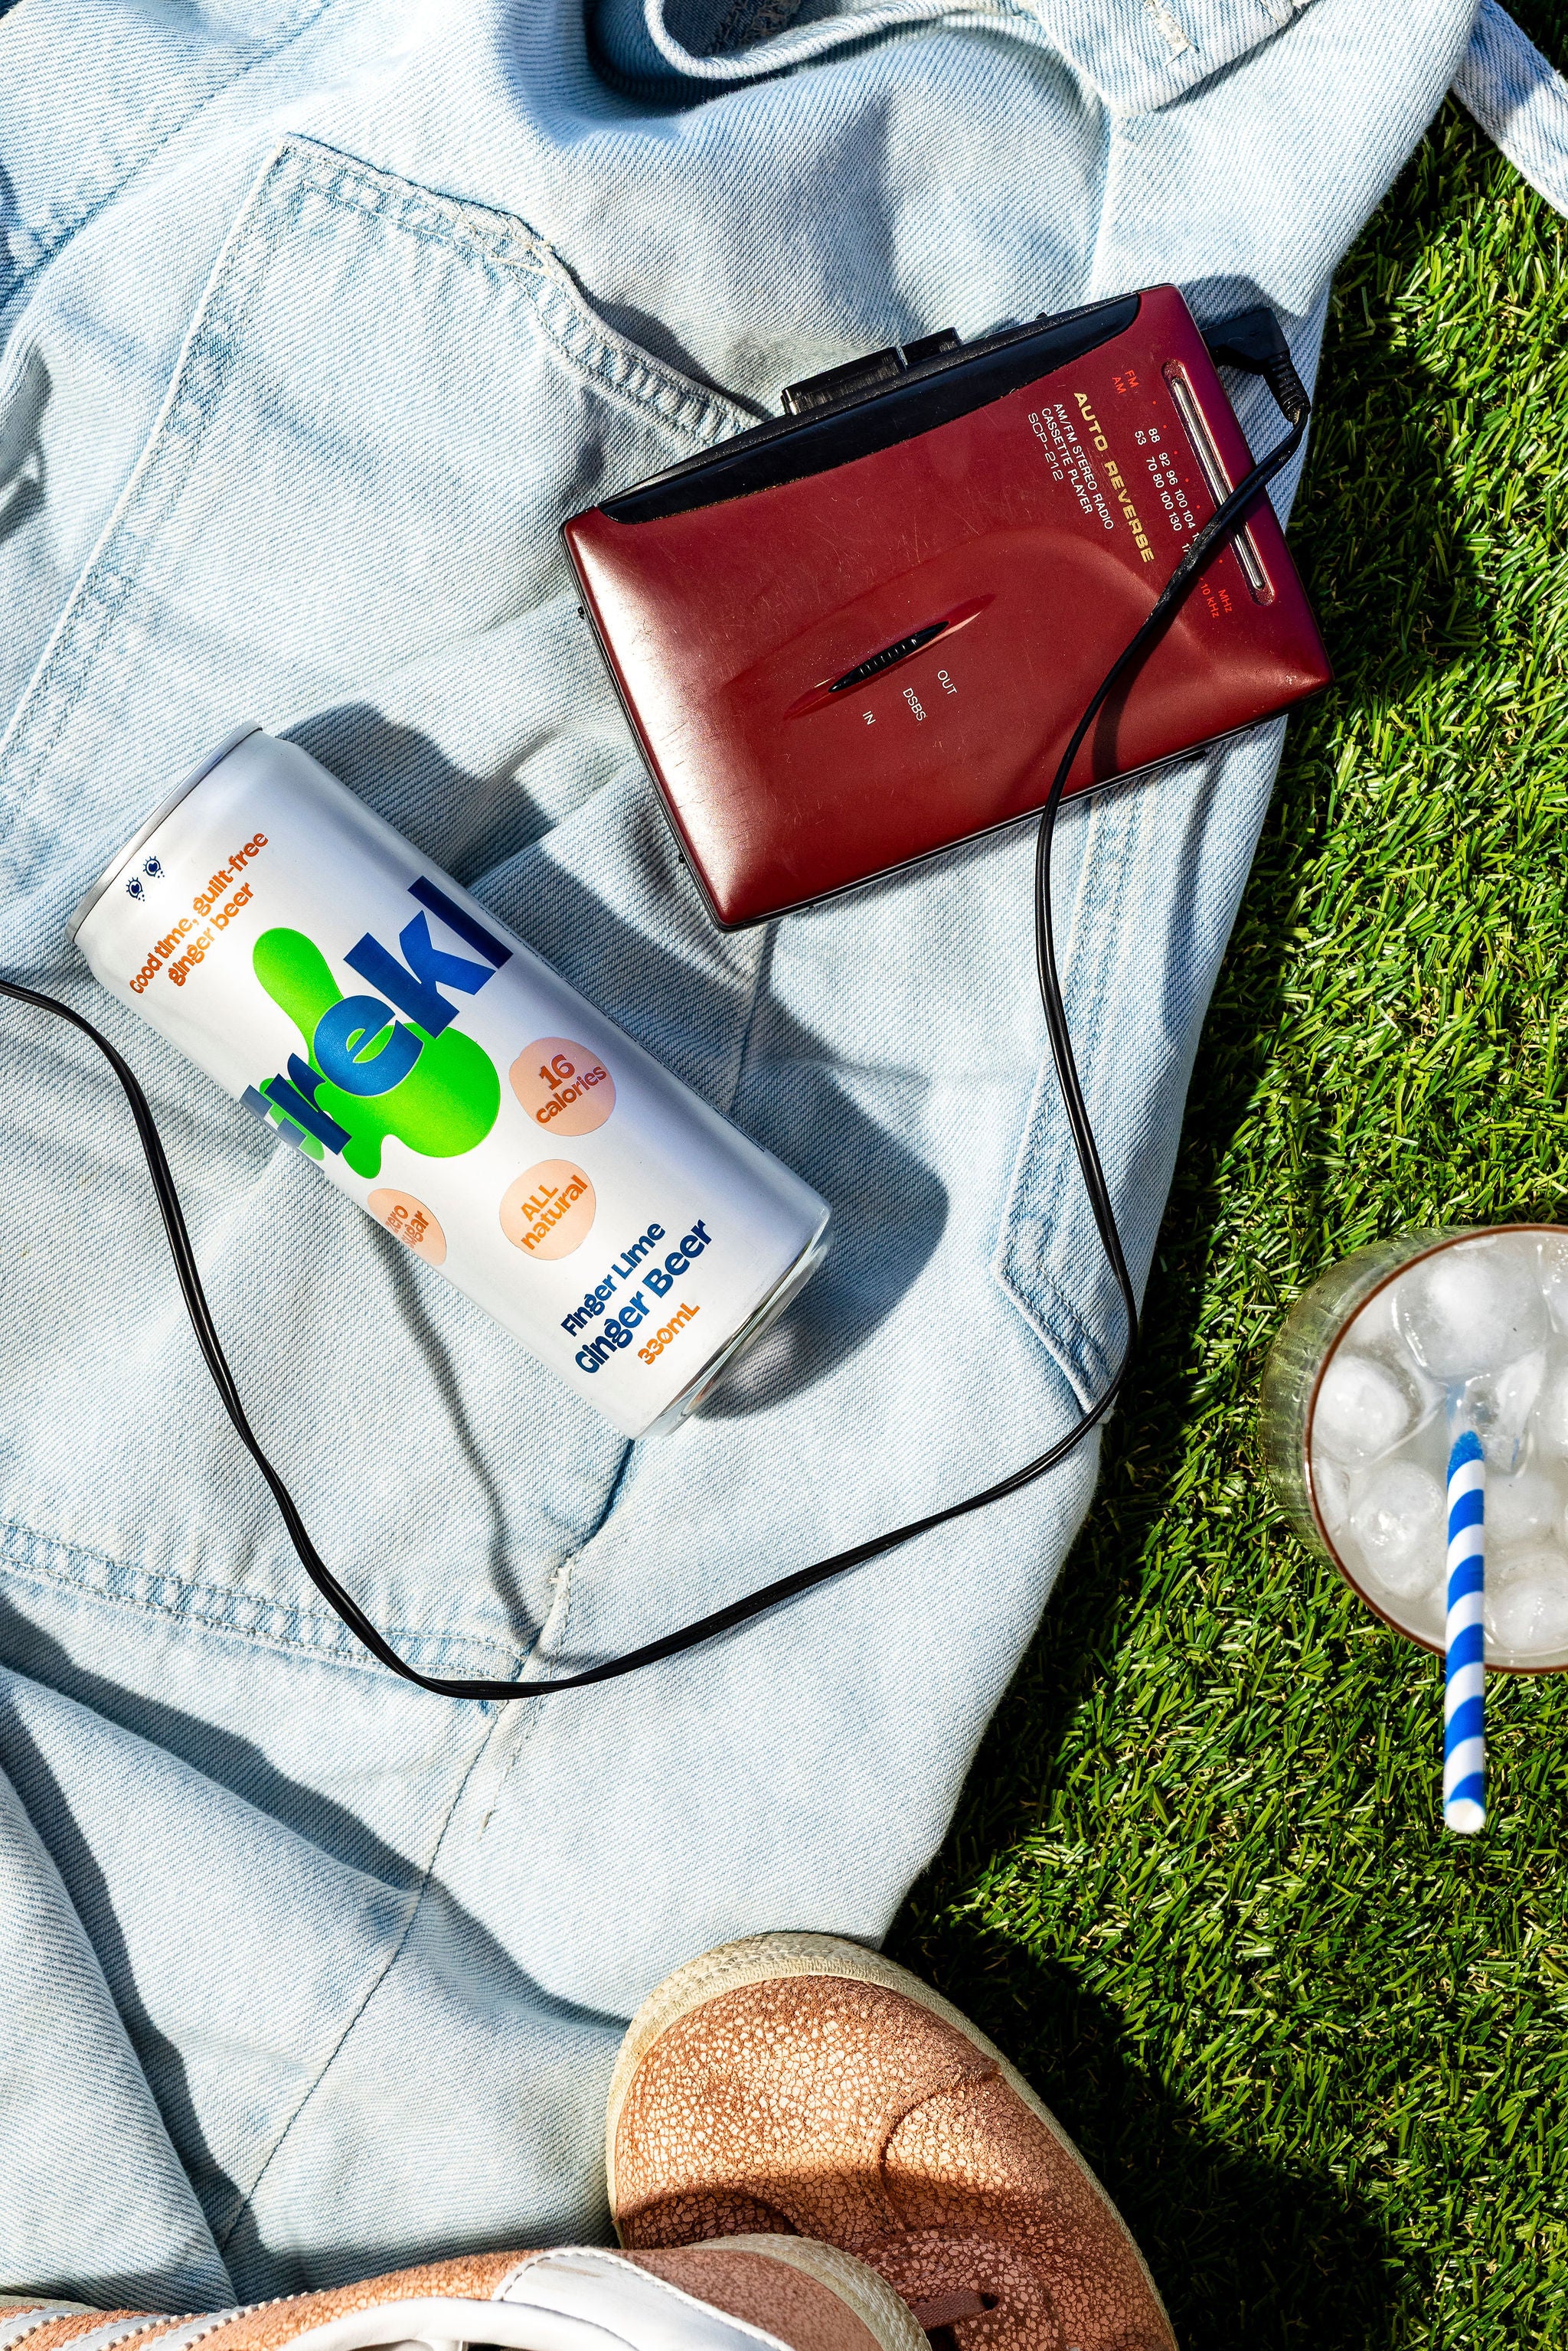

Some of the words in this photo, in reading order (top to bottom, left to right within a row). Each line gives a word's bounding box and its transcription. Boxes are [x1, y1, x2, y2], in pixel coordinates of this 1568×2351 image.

[1112, 377, 1127, 394] AM
[1124, 370, 1139, 388] FM
[1027, 413, 1064, 482] SCP-212
[1041, 407, 1073, 466] CASSETTE
[1067, 469, 1093, 514] PLAYER
[1054, 403, 1078, 442] AM/FM
[1073, 445, 1098, 491] STEREO
[1093, 493, 1114, 530] RADIO
[1073, 392, 1109, 452] AUTO
[1104, 461, 1155, 563] REVERSE
[1135, 430, 1147, 446] 53
[1146, 456, 1158, 472] 70
[1153, 473, 1165, 488] 80
[1160, 491, 1174, 510] 100
[1168, 512, 1182, 531] 130
[1148, 428, 1161, 443] 88
[1158, 452, 1170, 467] 92
[1166, 470, 1178, 485] 96
[1174, 489, 1188, 508] 100
[1182, 510, 1196, 529] 104
[1207, 596, 1220, 619] kHz
[1218, 589, 1233, 613] MHz
[902, 687, 926, 721] DSBS
[937, 670, 957, 695] OUT
[862, 710, 877, 726] IN
[129, 952, 163, 994] Good
[154, 918, 200, 959] time,
[193, 833, 269, 917] guilt-free
[168, 927, 215, 987] ginger
[210, 882, 254, 932] beer
[536, 1066, 607, 1124] calories
[539, 1053, 575, 1091] 16
[384, 1205, 409, 1234] zero
[401, 1210, 429, 1249] sugar
[521, 1184, 559, 1223] ALL
[521, 1174, 588, 1250] natural
[560, 1274, 618, 1337] Finger
[611, 1223, 666, 1280] Lime
[574, 1291, 651, 1373] Ginger
[642, 1219, 712, 1298] Beer
[637, 1302, 701, 1366] 330mL
